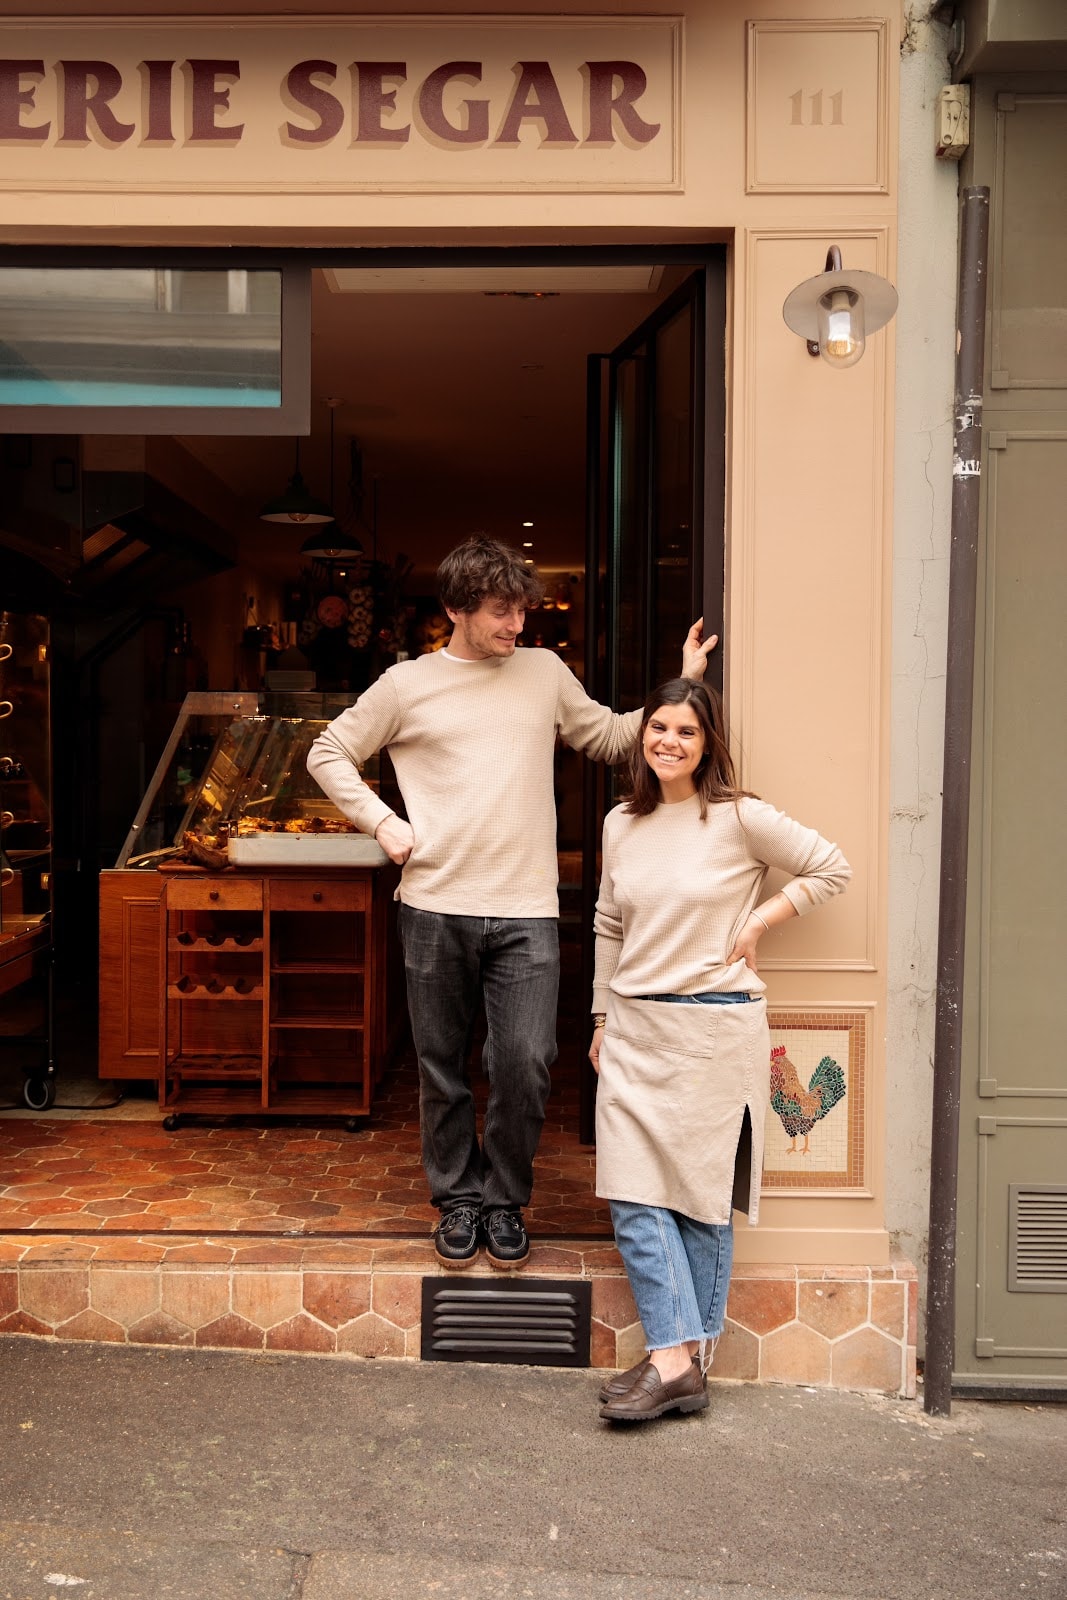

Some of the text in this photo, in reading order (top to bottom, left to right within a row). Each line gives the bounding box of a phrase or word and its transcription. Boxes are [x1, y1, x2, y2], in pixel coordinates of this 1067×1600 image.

[0, 59, 661, 148] ERIE SEGAR
[787, 88, 844, 126] 111
